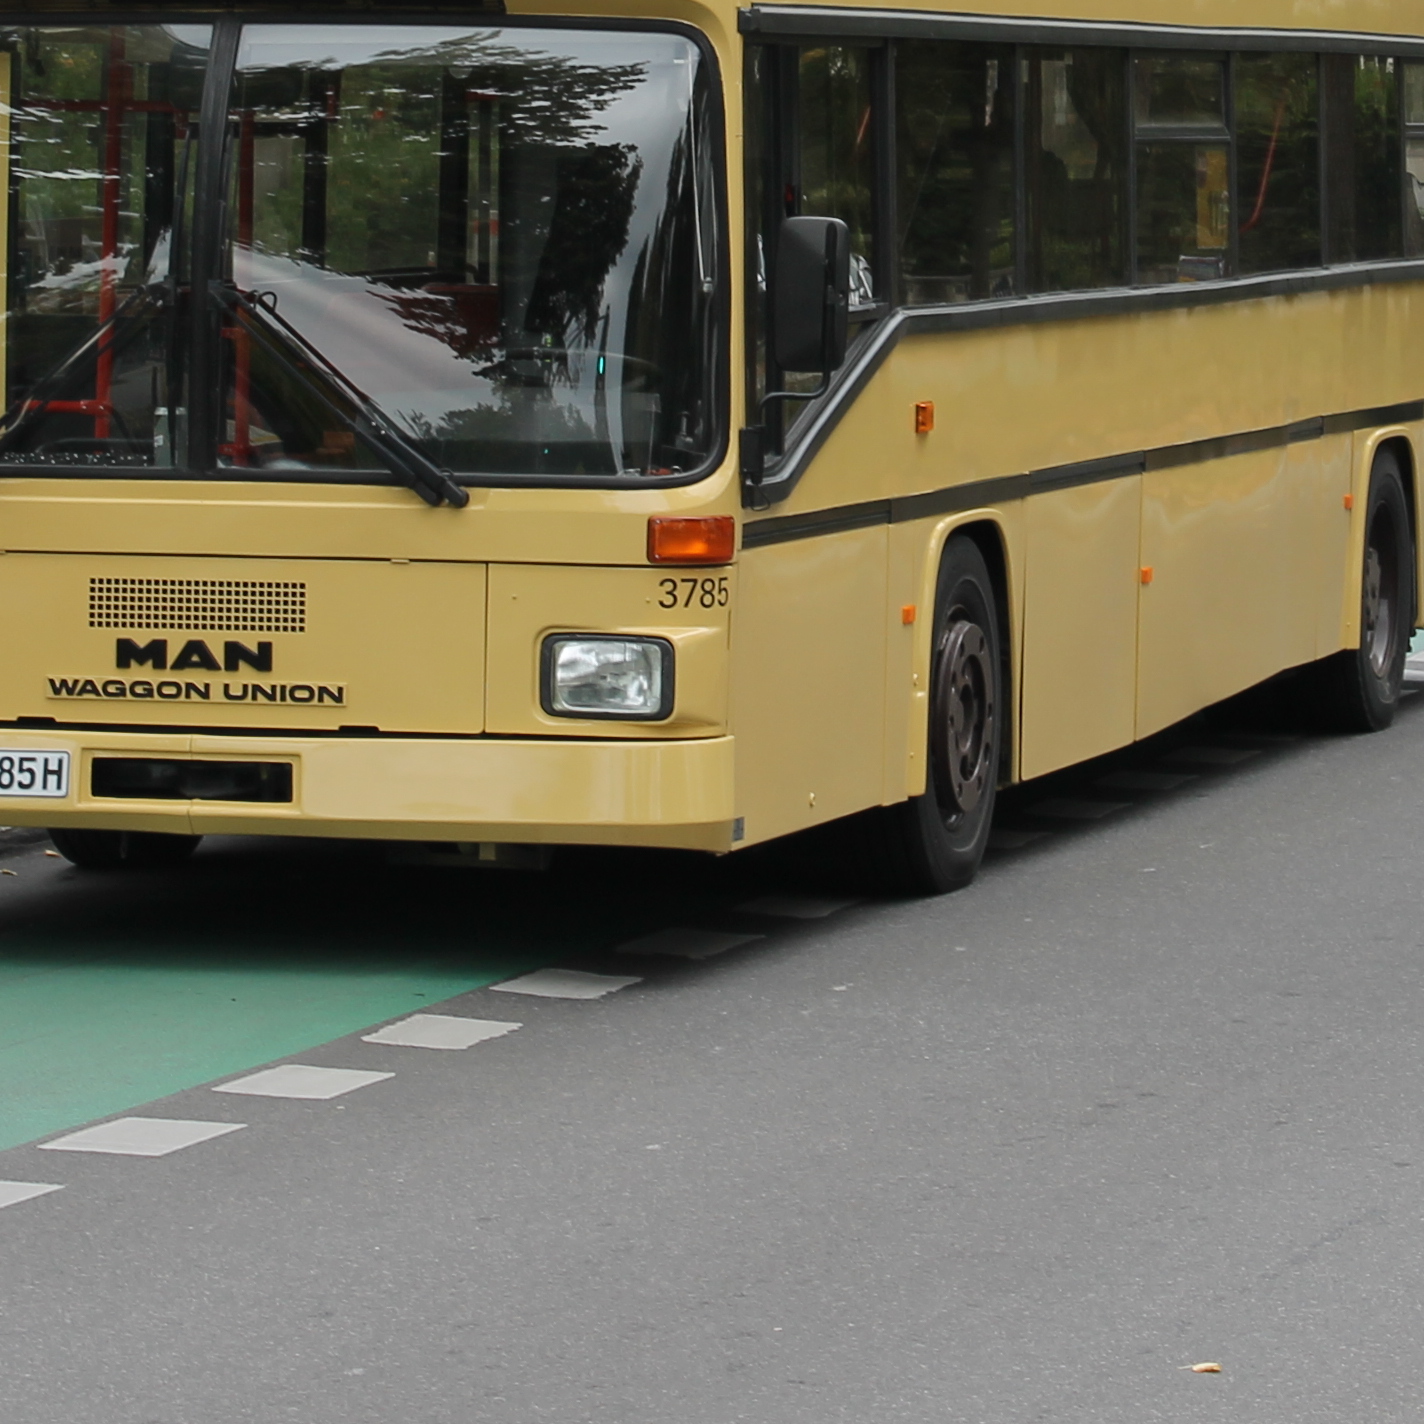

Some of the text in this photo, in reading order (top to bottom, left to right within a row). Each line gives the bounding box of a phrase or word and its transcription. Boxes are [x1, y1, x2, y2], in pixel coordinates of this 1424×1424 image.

[658, 575, 729, 608] 3785
[115, 637, 274, 672] MAN
[48, 677, 345, 705] WAGGON UNION
